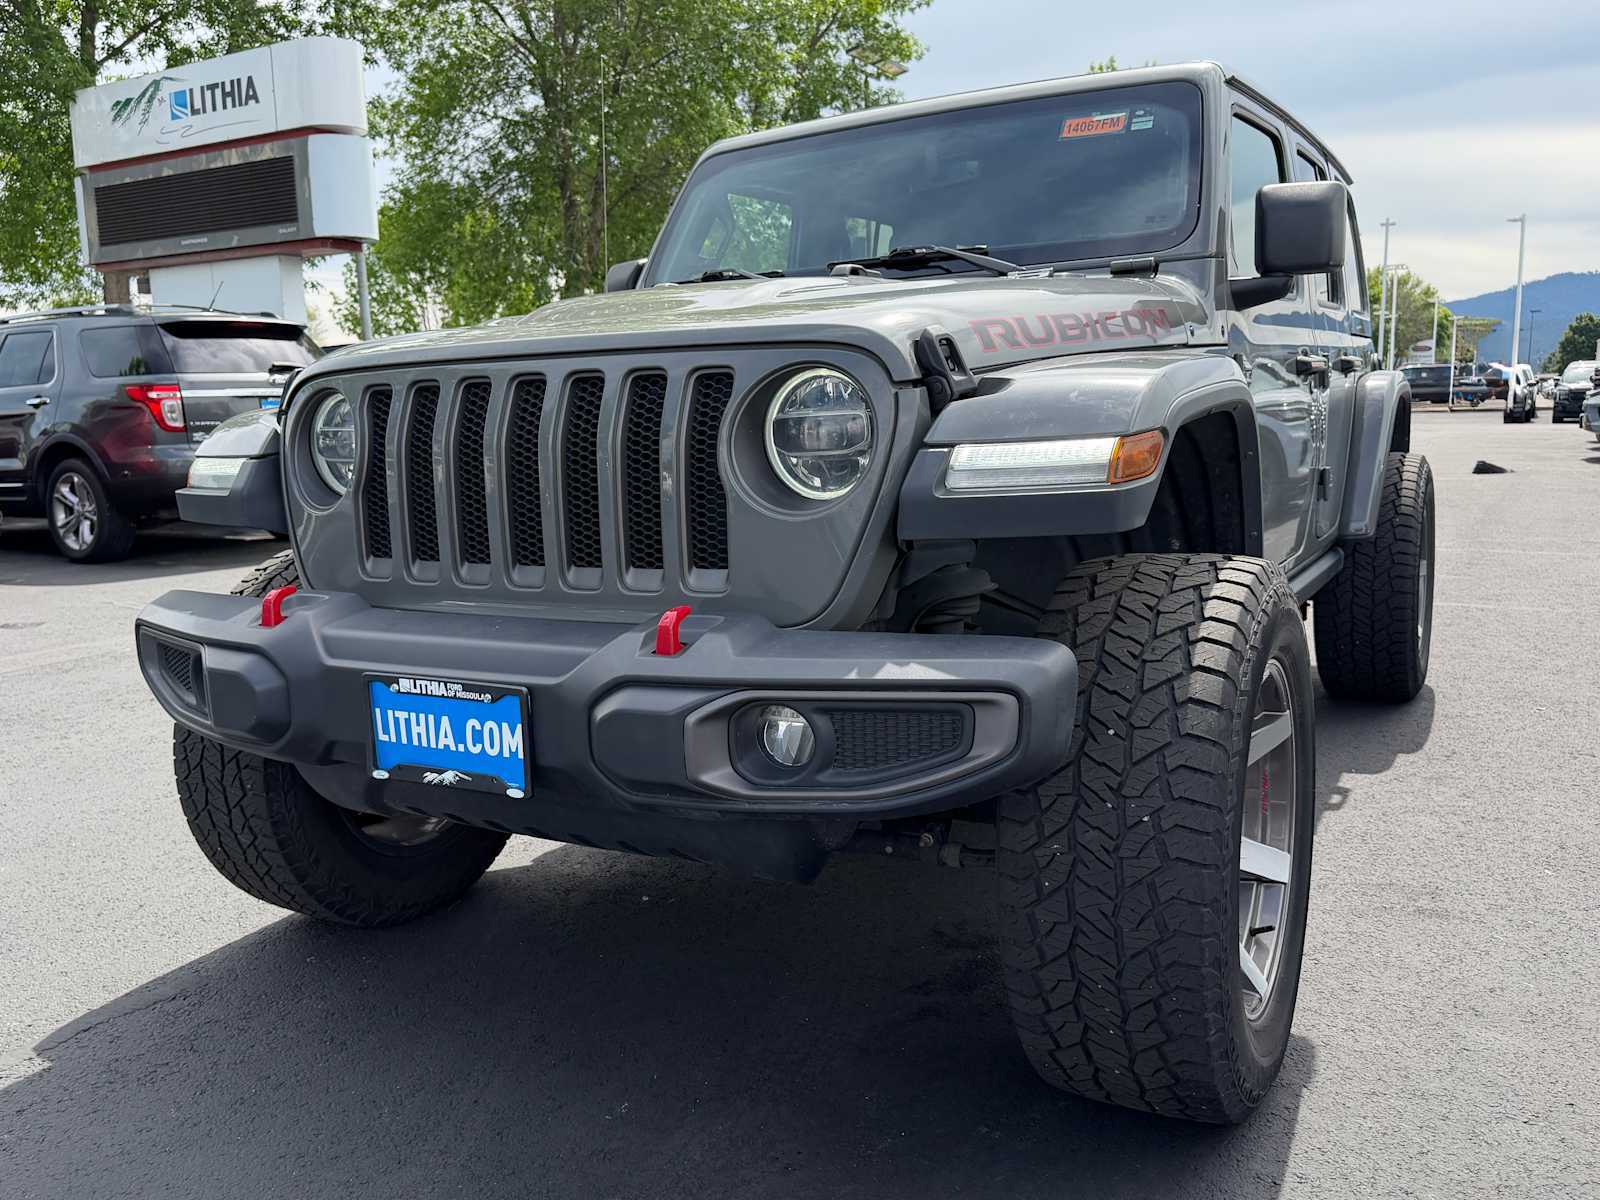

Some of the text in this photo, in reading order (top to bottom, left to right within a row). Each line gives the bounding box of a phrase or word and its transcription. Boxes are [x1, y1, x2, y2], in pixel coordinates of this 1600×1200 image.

[188, 75, 260, 117] LITHIA
[1066, 117, 1120, 135] 14067FM
[968, 307, 1172, 353] RUBICON
[409, 679, 448, 697] LITHIA
[456, 691, 485, 701] MISSOULA
[375, 707, 525, 760] LITHIA.COM
